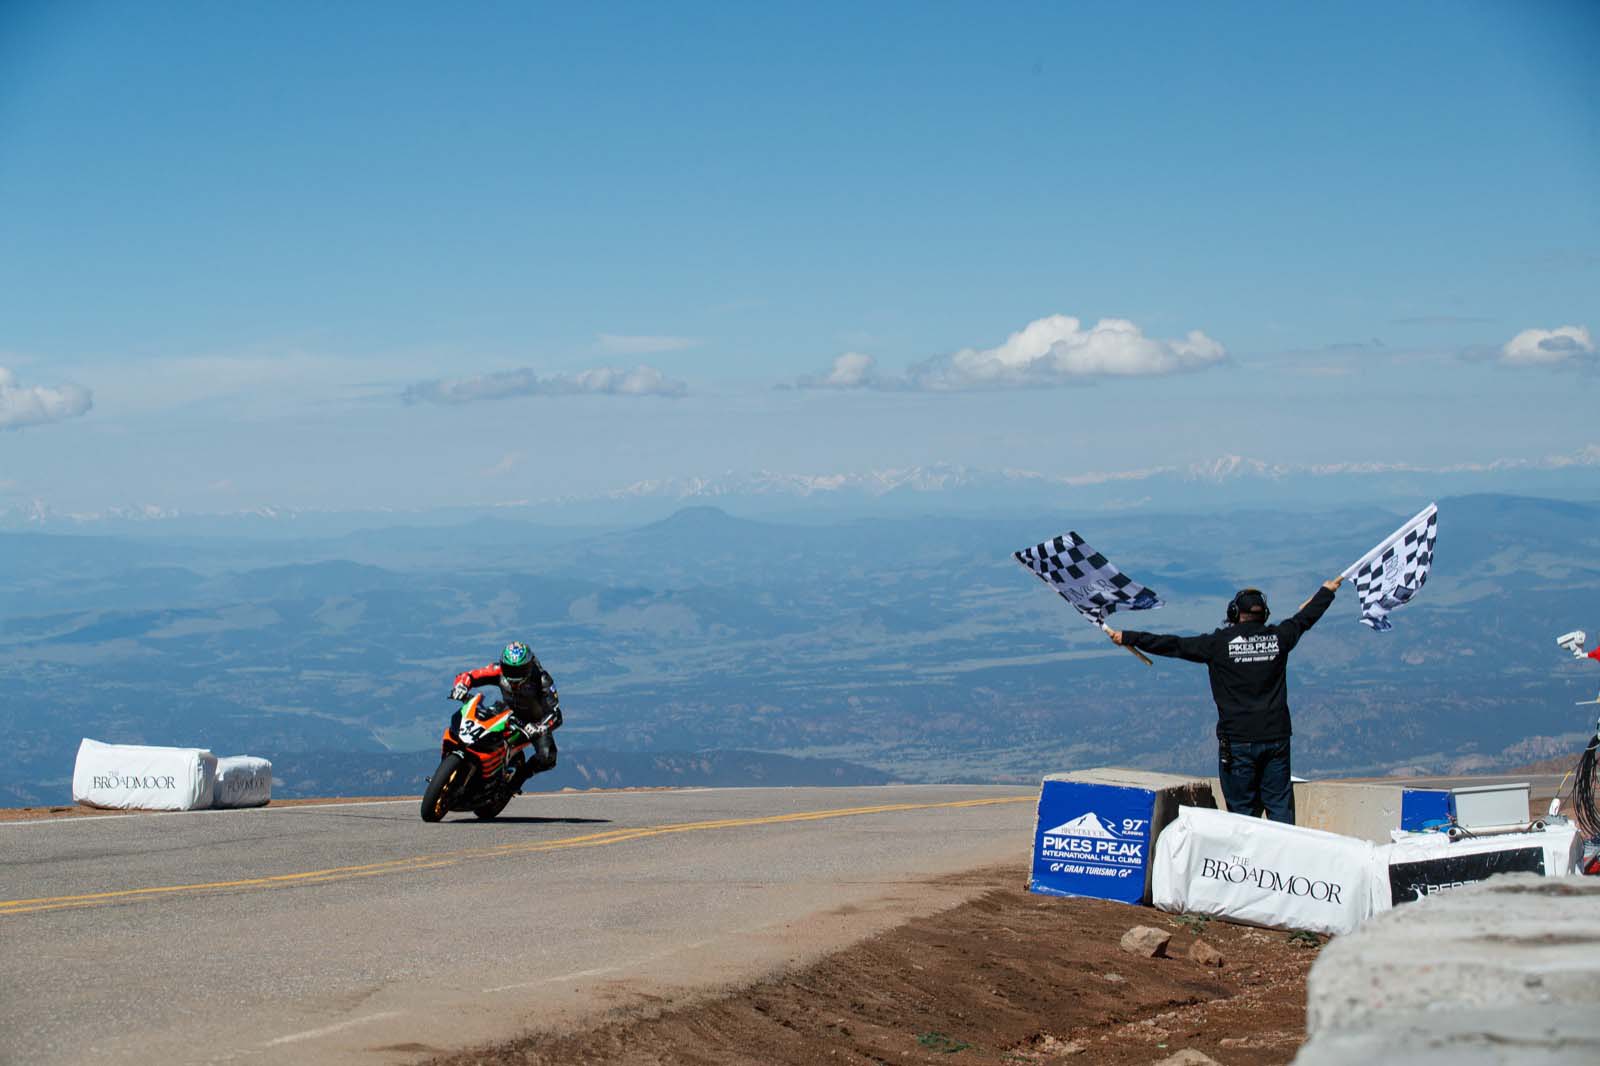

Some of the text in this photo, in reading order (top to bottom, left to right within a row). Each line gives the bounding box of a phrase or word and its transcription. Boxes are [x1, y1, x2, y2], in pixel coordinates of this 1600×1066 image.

[1228, 641, 1279, 651] PIKES PEAK
[460, 719, 486, 741] 34
[93, 775, 176, 790] BROADMOOR
[1042, 836, 1143, 857] PIKES PEAK
[1042, 849, 1142, 865] INTERNATIONAL HILL CLIMB
[1230, 854, 1250, 866] THE
[1064, 864, 1085, 874] GRAN
[1085, 866, 1117, 877] TURISMO
[1201, 857, 1343, 905] BROADMOOR
